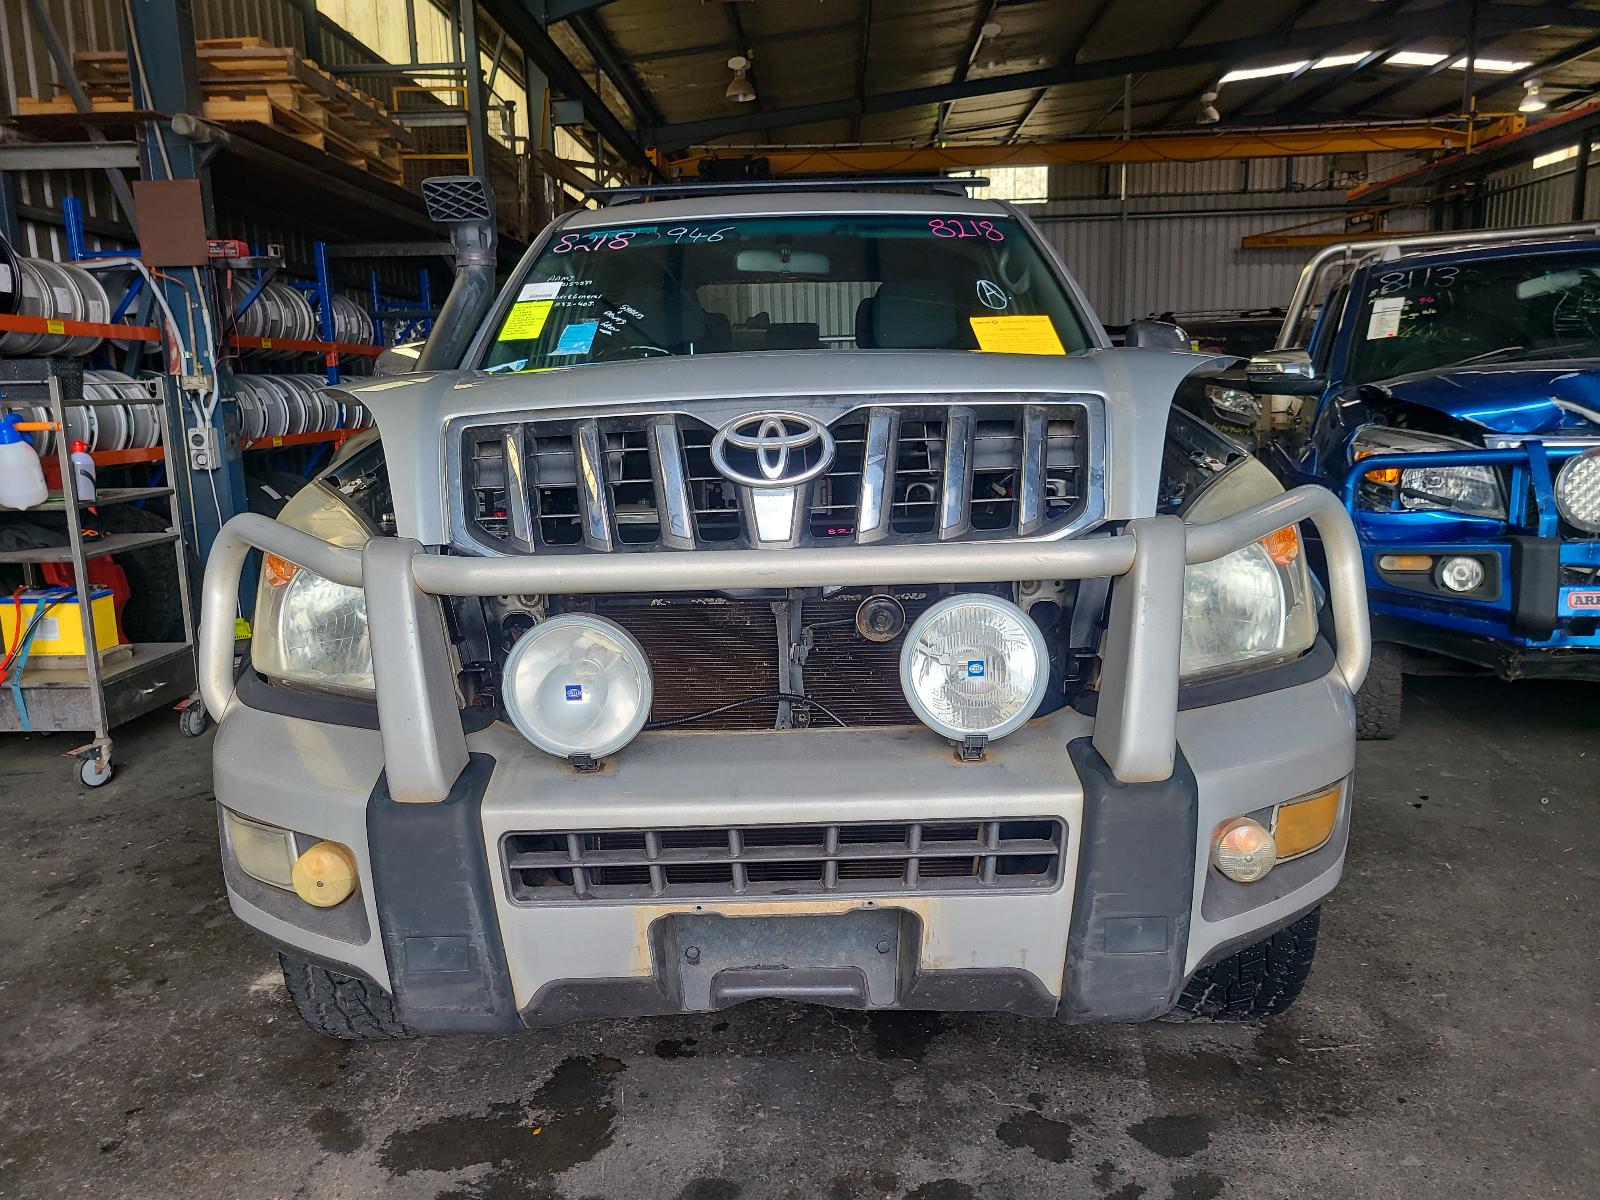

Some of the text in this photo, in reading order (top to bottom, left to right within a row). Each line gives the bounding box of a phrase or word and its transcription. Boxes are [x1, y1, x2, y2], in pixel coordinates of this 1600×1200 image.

[928, 219, 1005, 241] 8218
[553, 231, 637, 253] 8218
[1380, 266, 1460, 294] 8113
